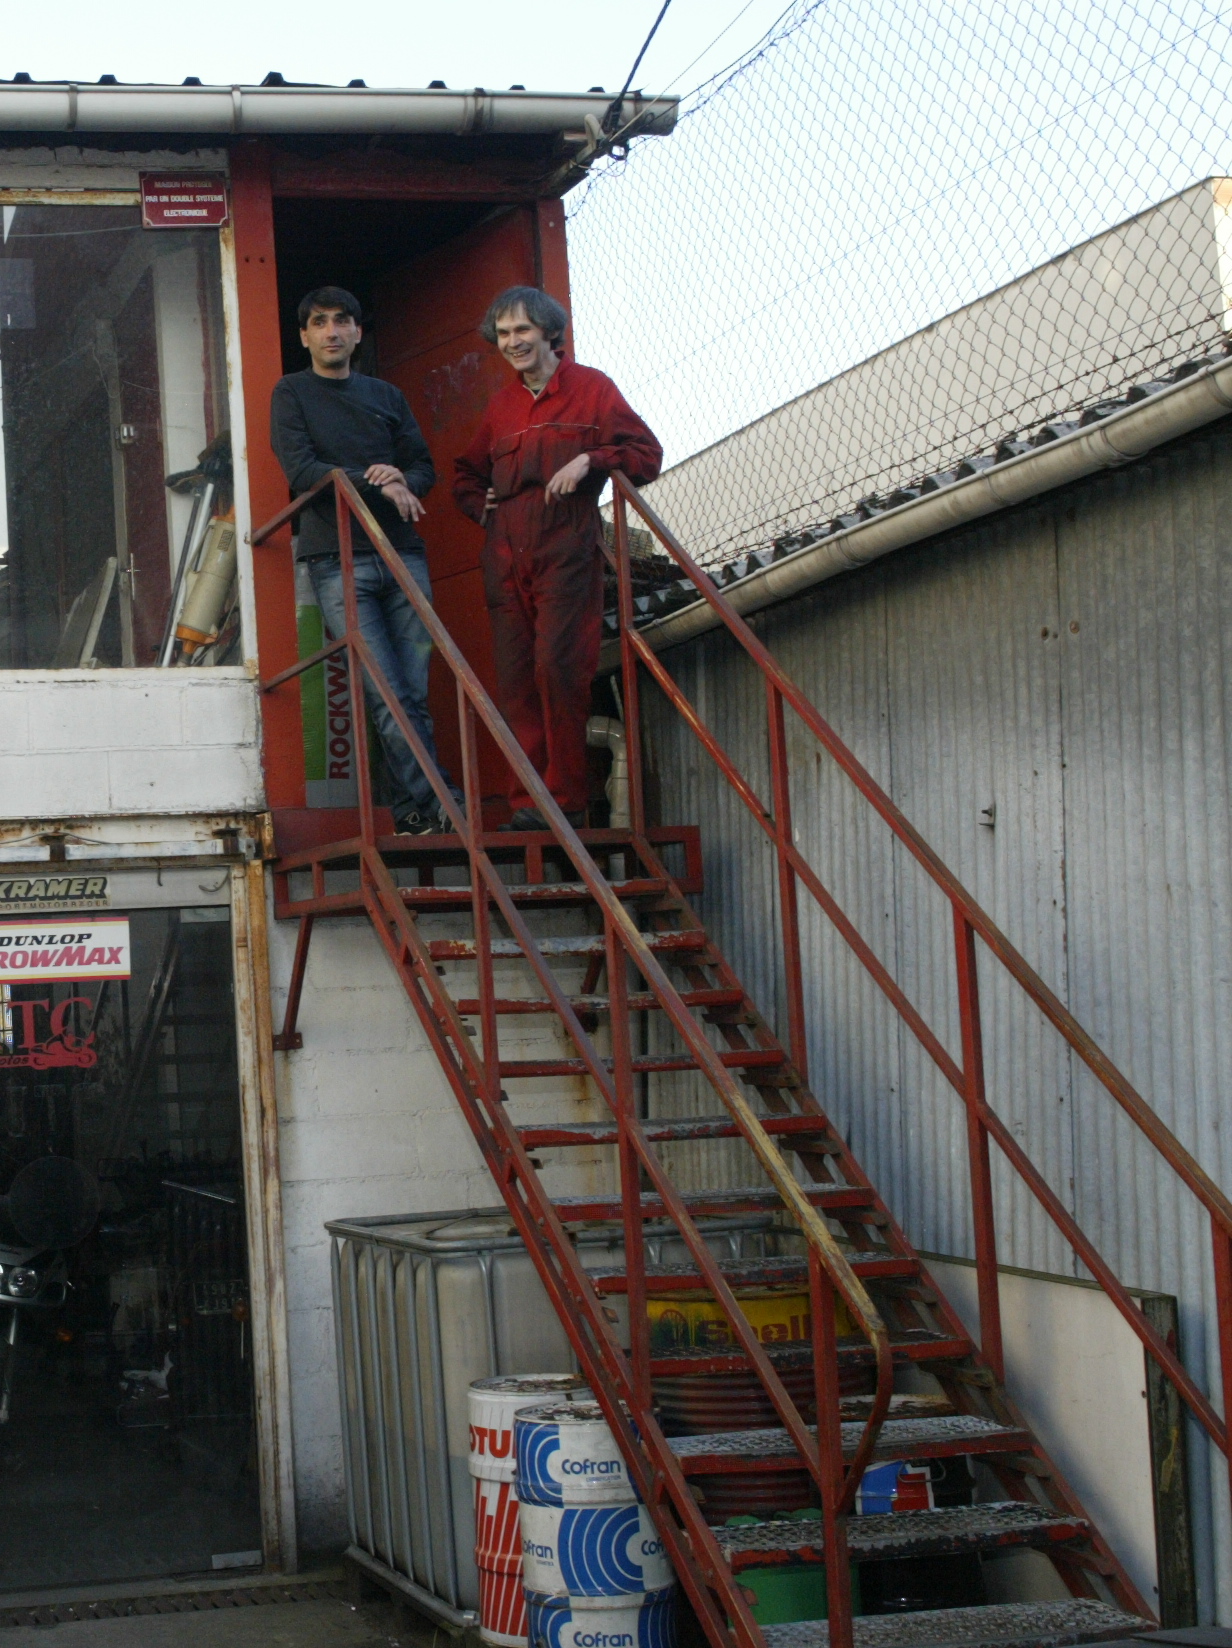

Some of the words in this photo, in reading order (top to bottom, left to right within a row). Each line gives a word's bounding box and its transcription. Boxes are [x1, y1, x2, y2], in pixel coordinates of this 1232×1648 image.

[561, 1457, 621, 1475] Cofran
[523, 1538, 554, 1560] ofran
[573, 1629, 633, 1648] Cofran
